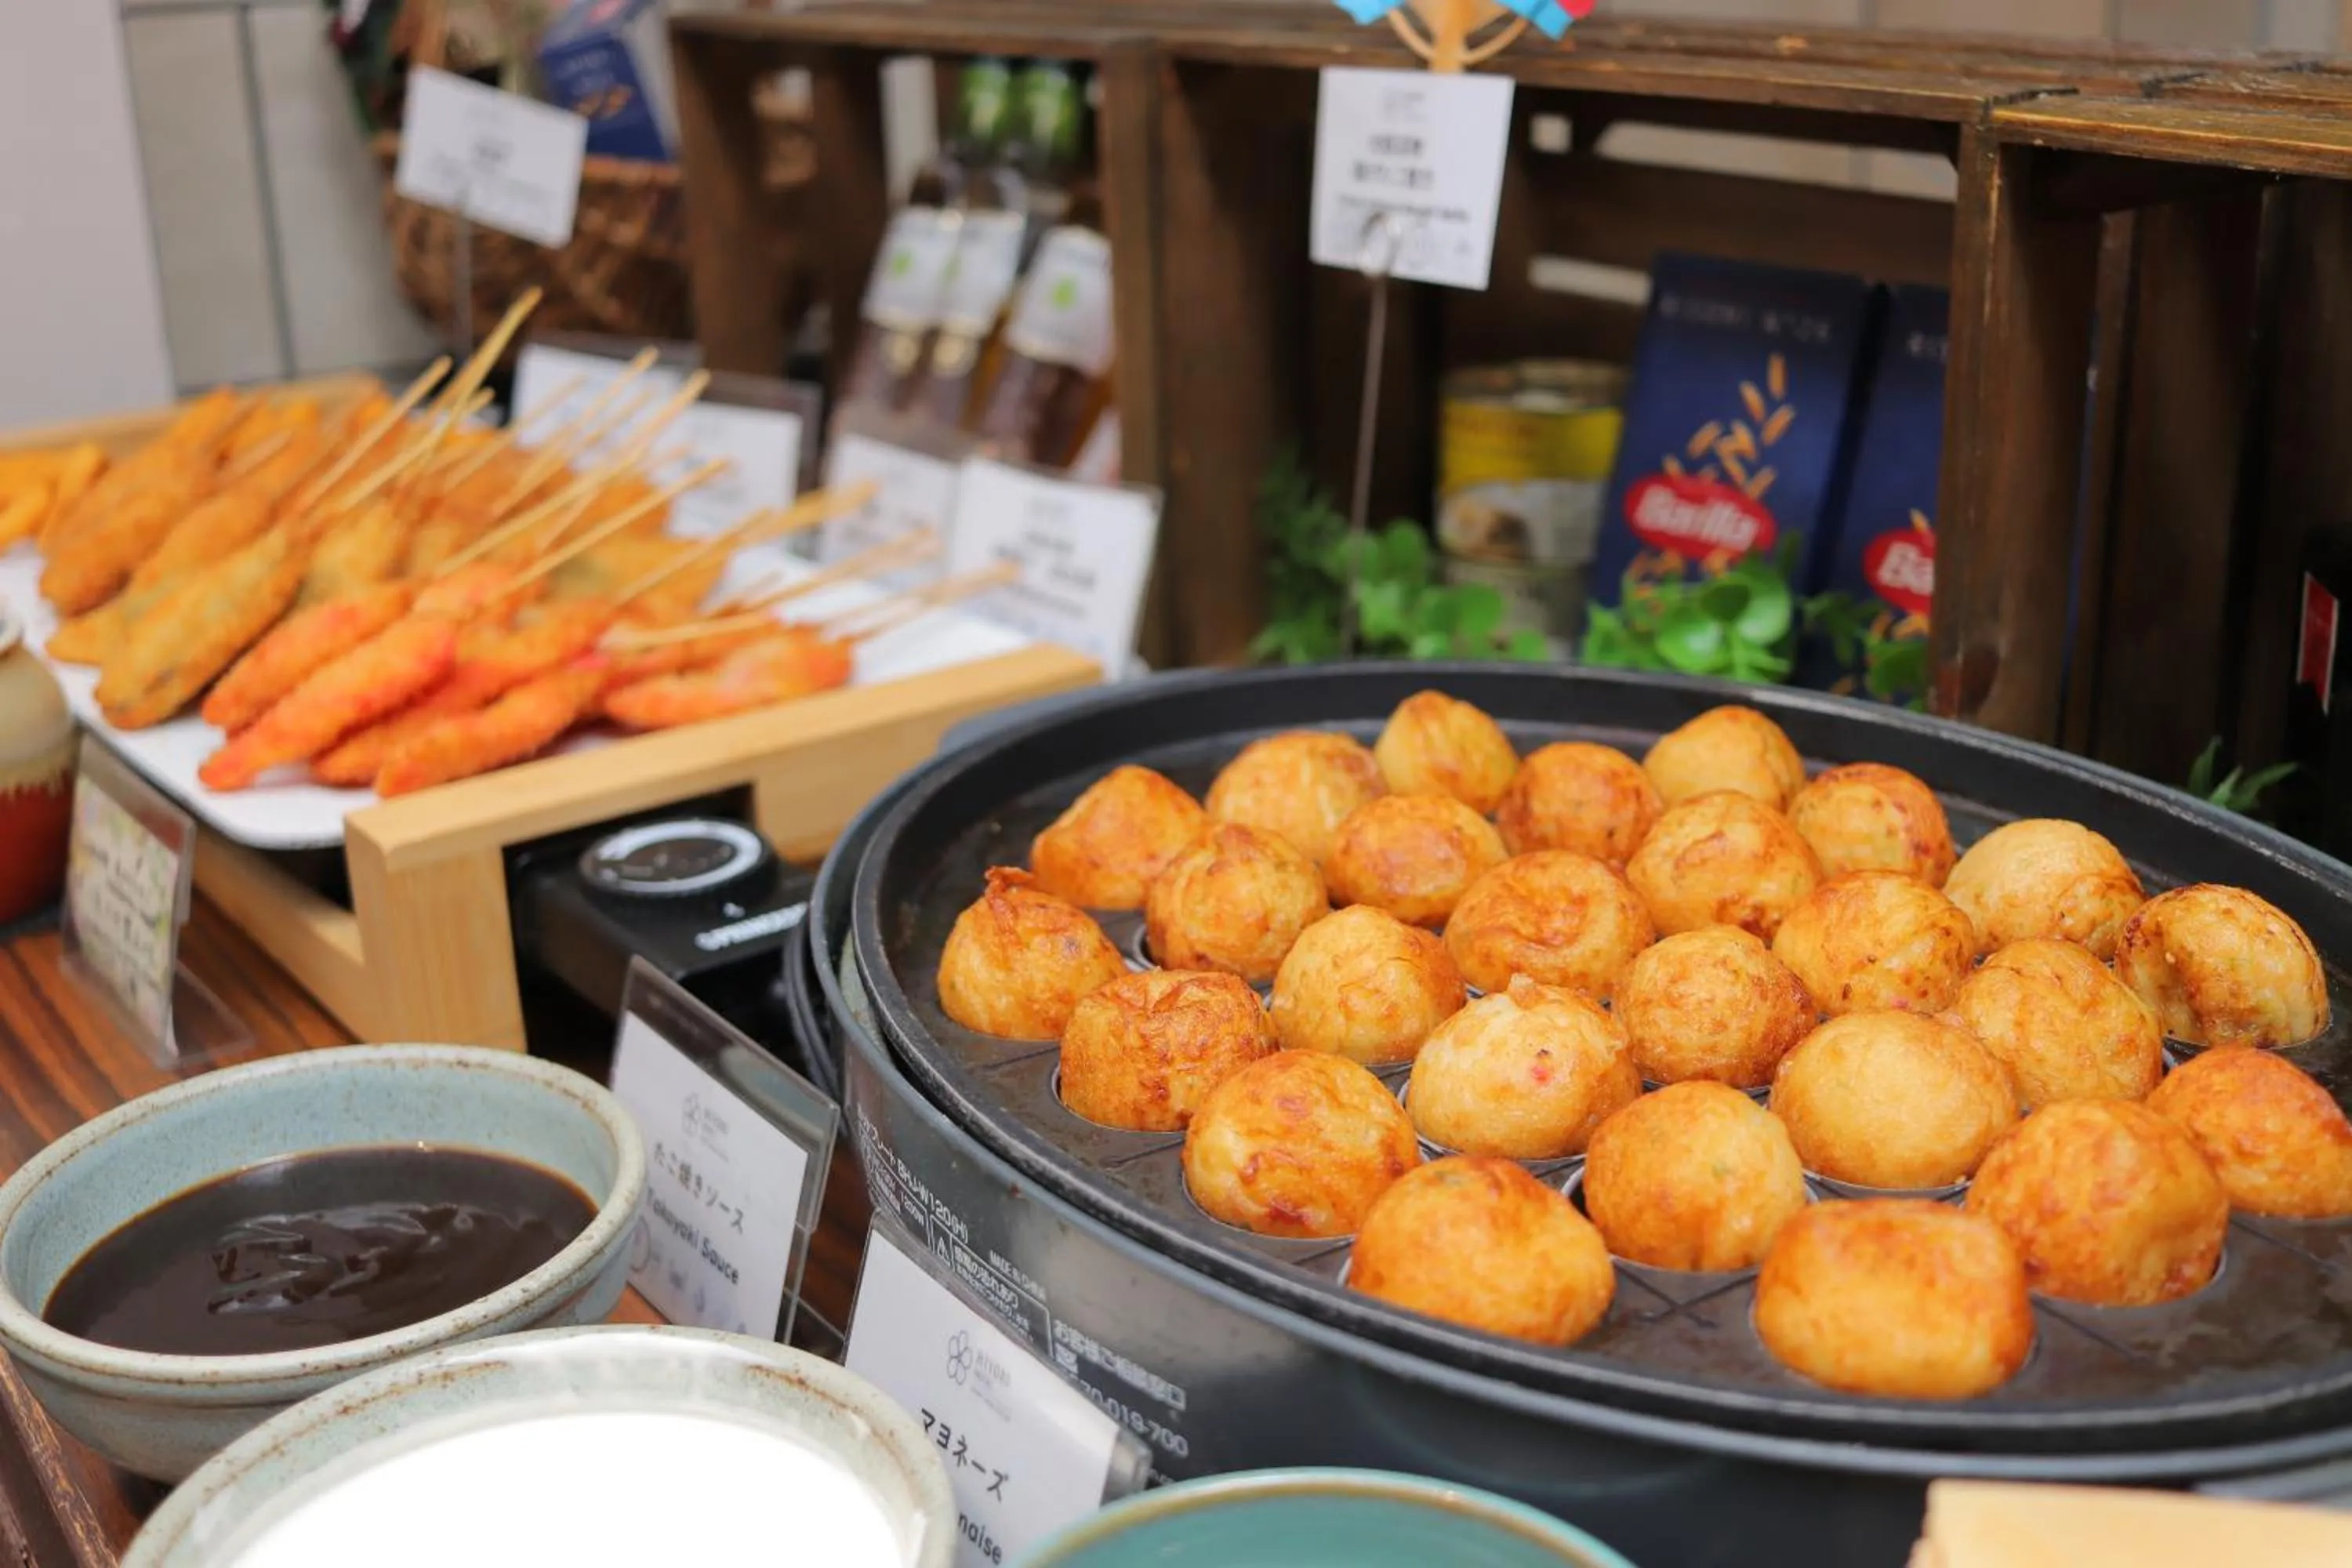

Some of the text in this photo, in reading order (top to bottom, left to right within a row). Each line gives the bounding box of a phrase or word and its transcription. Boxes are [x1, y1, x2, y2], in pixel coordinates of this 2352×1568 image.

[653, 1142, 745, 1236] たこ焼きソース
[702, 1236, 740, 1286] Sauce
[920, 1407, 1010, 1504] マヨネーズ
[958, 1512, 1003, 1566] naise
